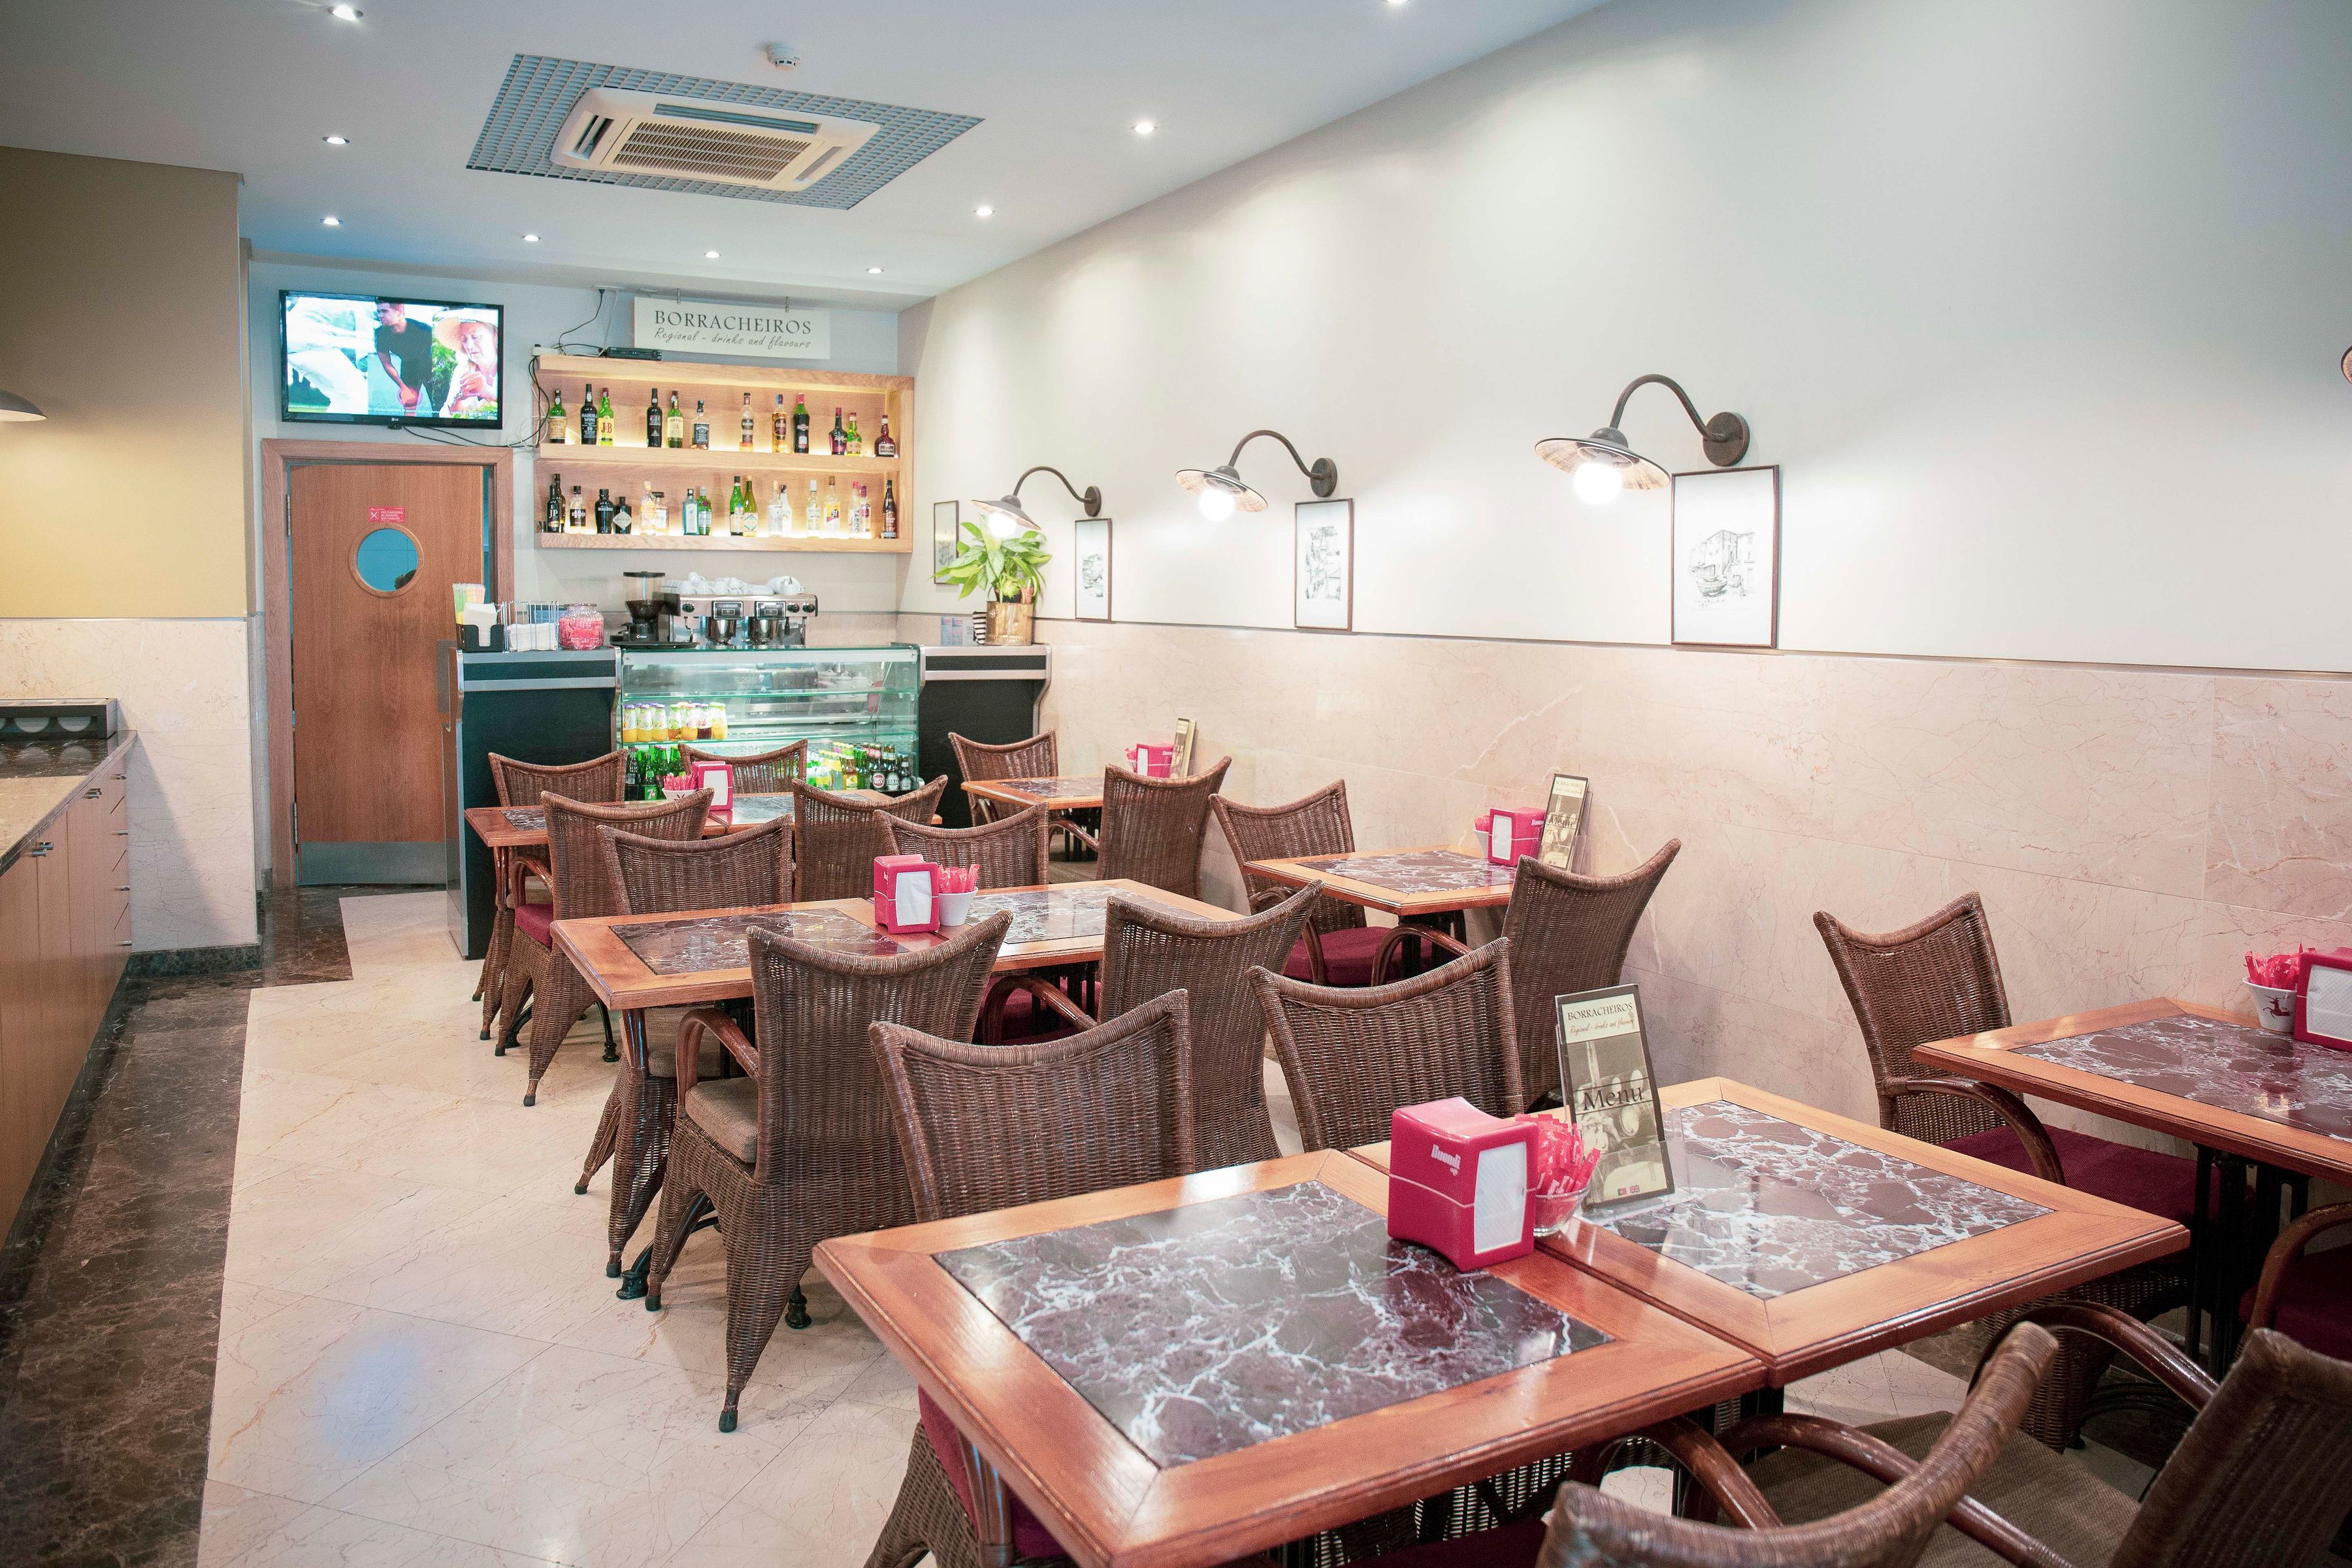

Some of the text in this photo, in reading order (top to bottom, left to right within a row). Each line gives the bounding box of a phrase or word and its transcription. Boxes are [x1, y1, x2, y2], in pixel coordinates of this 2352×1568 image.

[654, 310, 811, 335] BORRACHEIROS
[654, 327, 699, 343] Regional
[711, 333, 743, 345] drinks
[748, 336, 764, 346] and
[768, 336, 811, 350] flavours
[549, 510, 558, 519] JP
[1567, 1002, 1633, 1021] BORRACHEIROS
[1583, 1086, 1643, 1111] Menu
